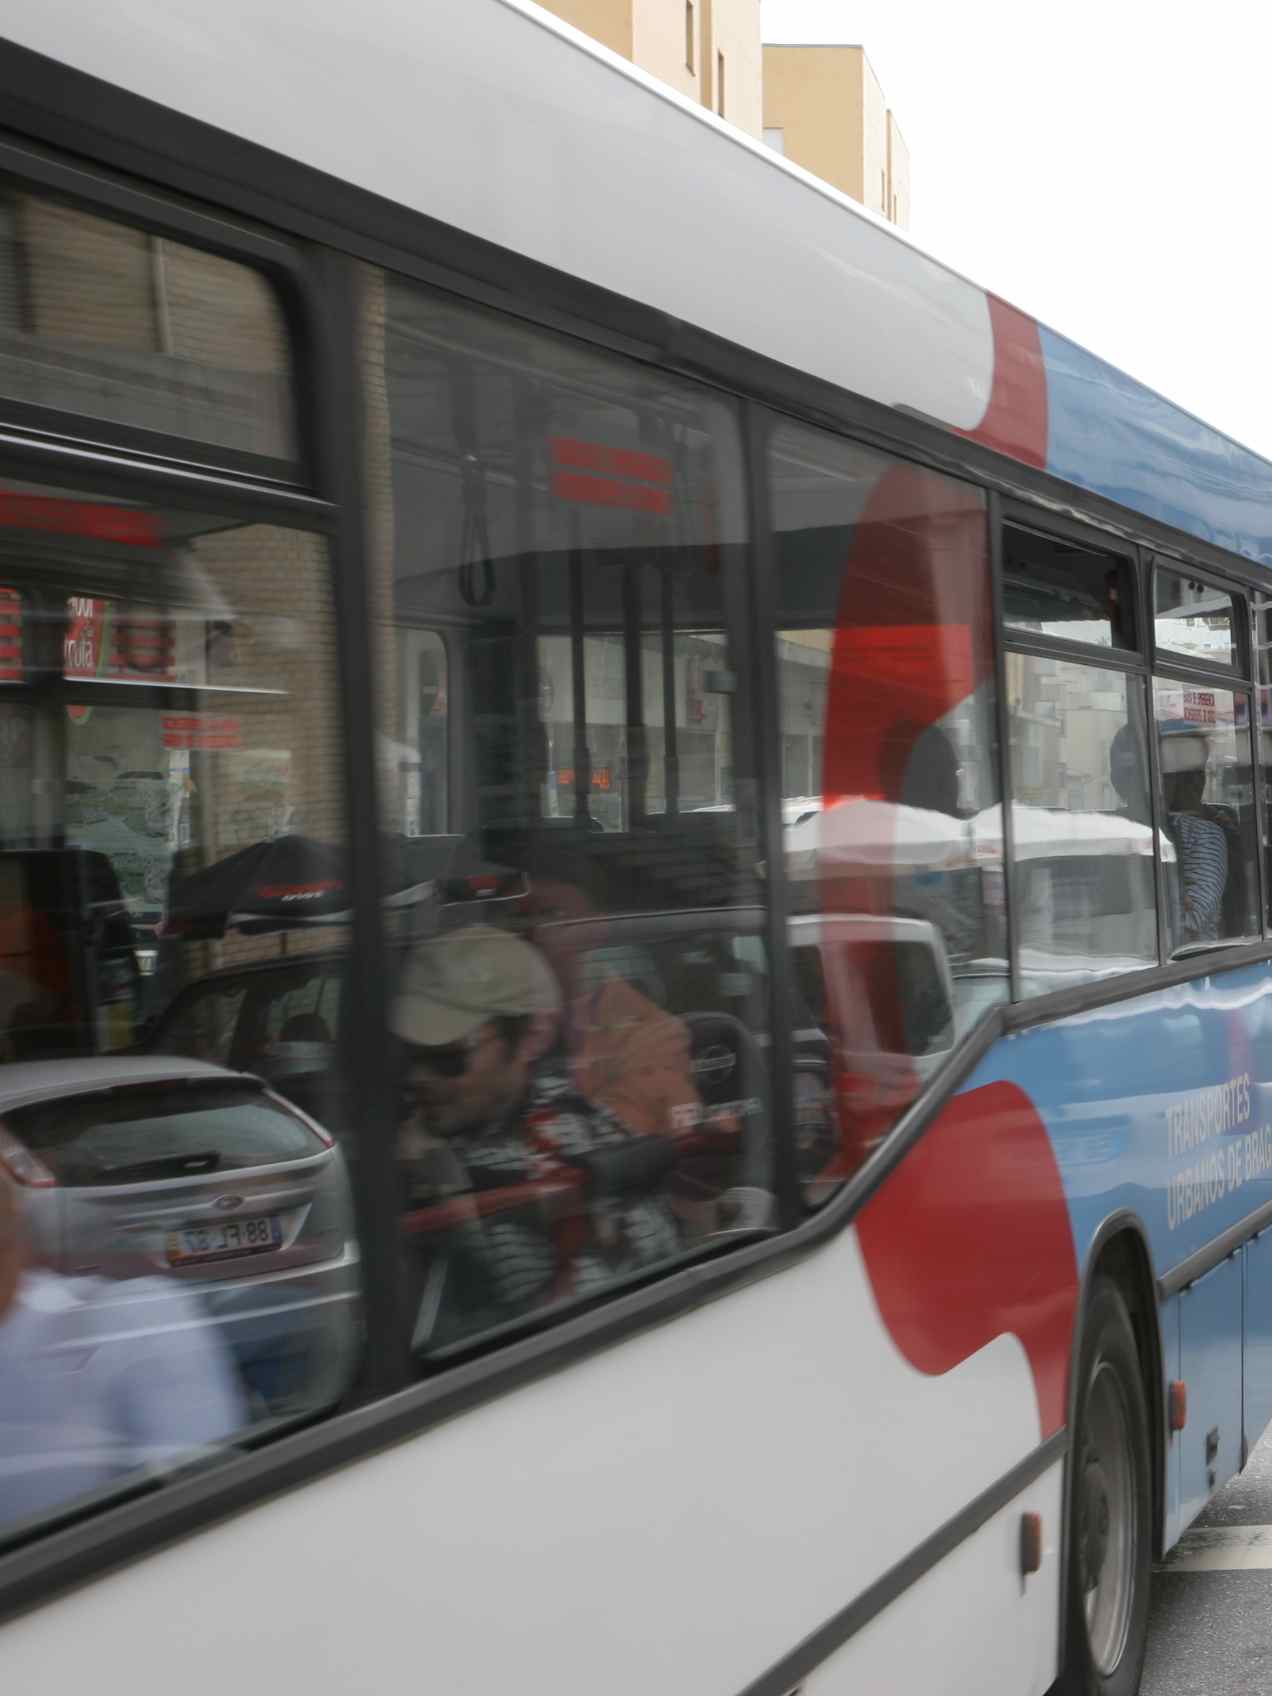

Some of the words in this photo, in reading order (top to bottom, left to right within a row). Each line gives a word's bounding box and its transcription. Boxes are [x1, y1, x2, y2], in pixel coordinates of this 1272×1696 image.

[1166, 1071, 1251, 1157] TRANSPORTES
[1168, 1148, 1225, 1231] URBANOS
[1227, 1139, 1243, 1192] DE
